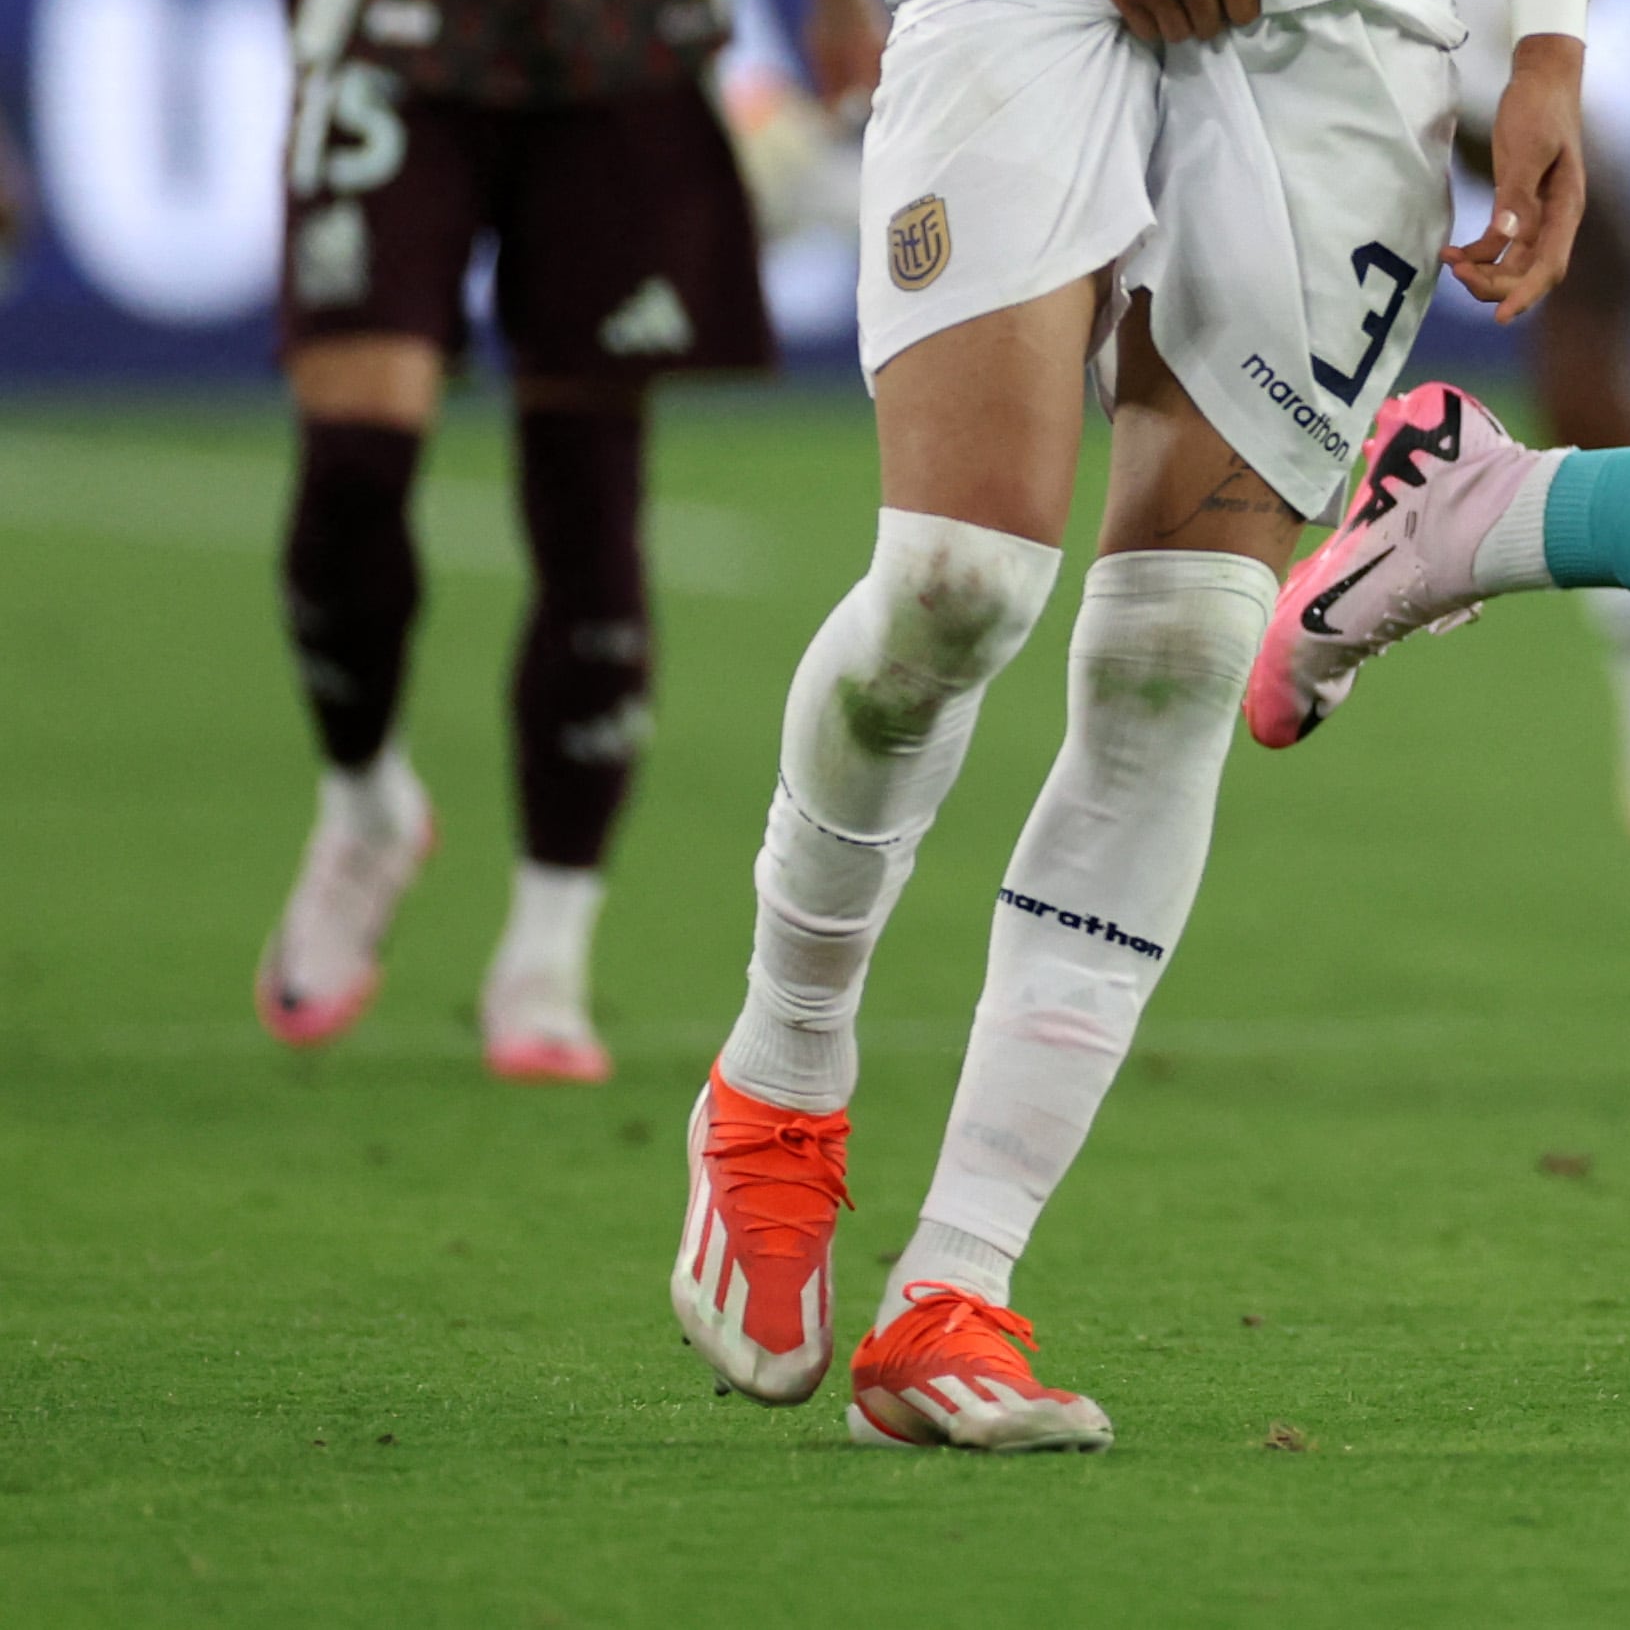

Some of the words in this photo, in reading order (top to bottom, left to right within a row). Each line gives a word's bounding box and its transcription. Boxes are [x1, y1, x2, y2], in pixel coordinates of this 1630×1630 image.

[291, 60, 406, 198] 15
[1308, 240, 1419, 409] 3
[1241, 353, 1350, 463] marathon
